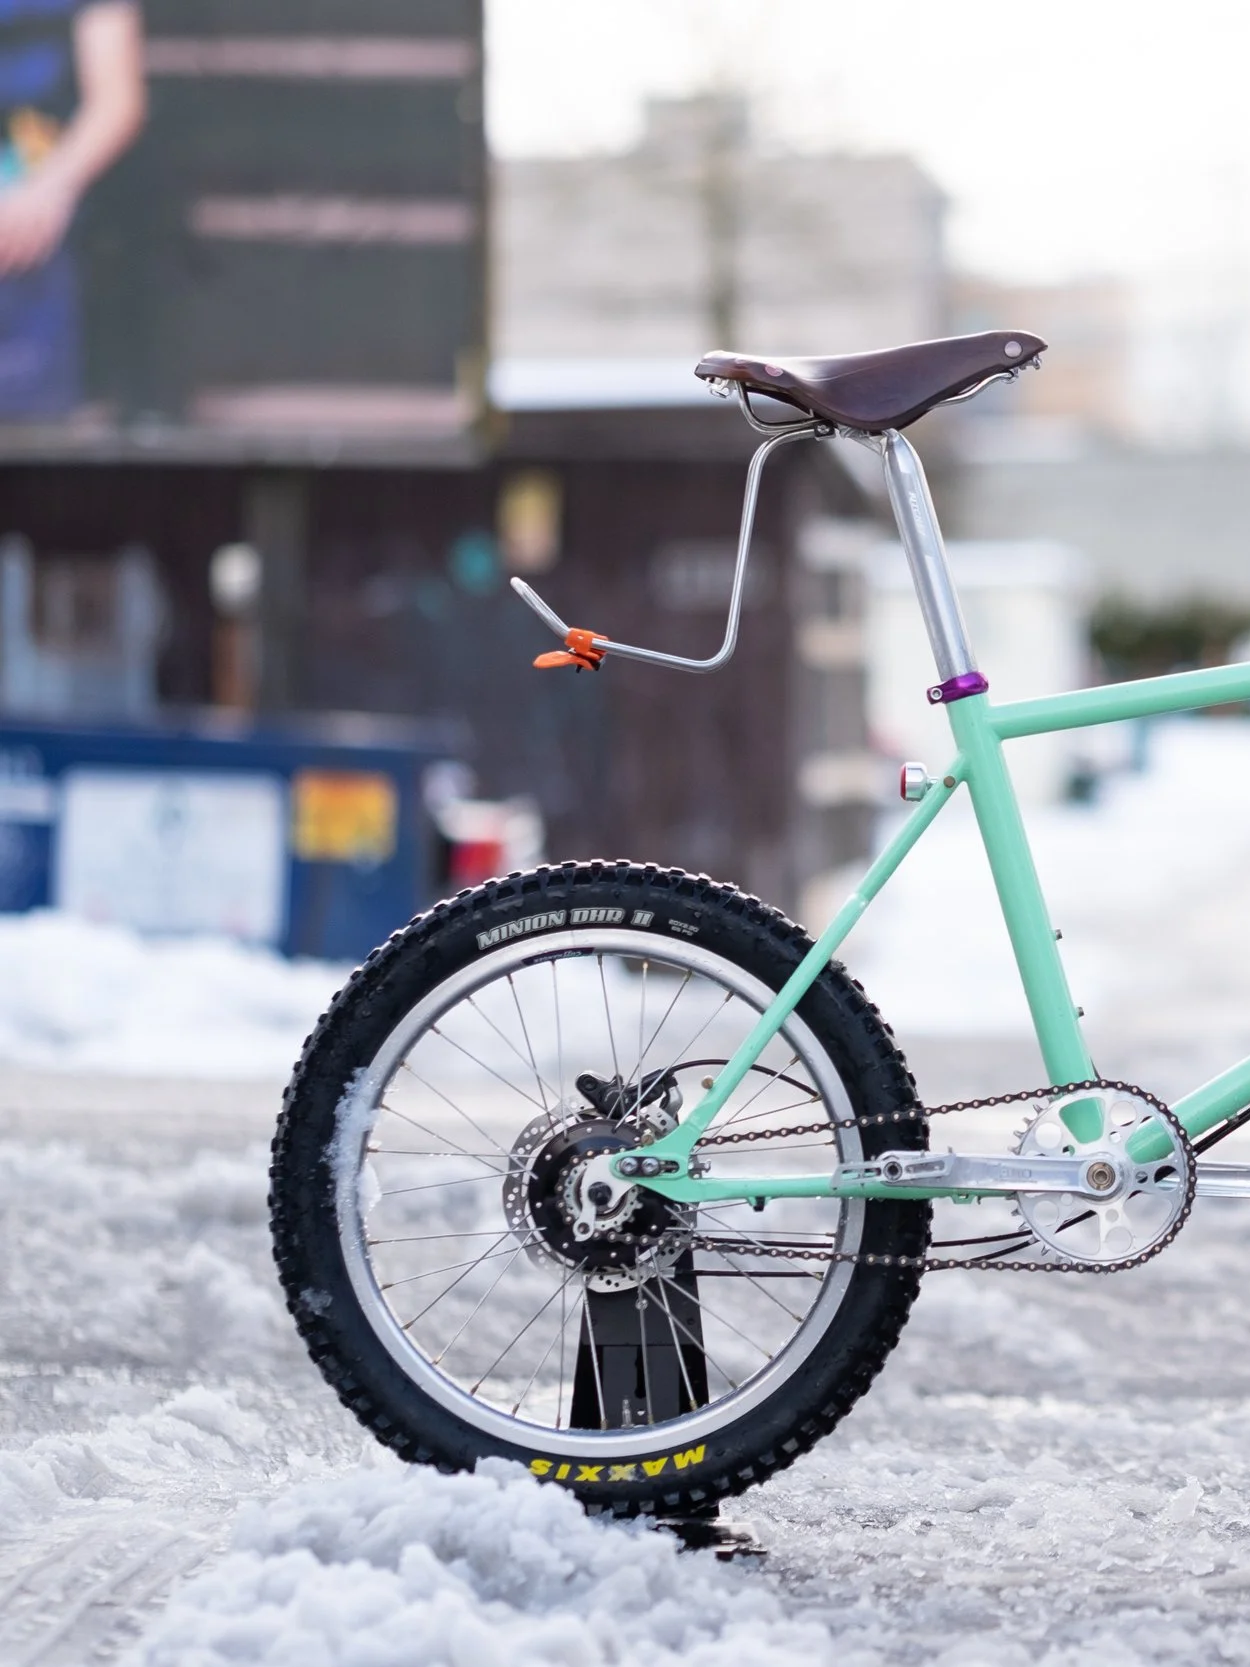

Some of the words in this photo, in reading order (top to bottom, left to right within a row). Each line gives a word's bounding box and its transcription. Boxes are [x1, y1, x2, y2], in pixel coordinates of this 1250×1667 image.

[476, 909, 567, 950] MINION
[569, 907, 627, 925] DHR
[630, 910, 655, 928] II
[529, 1444, 706, 1482] MAXXIS
